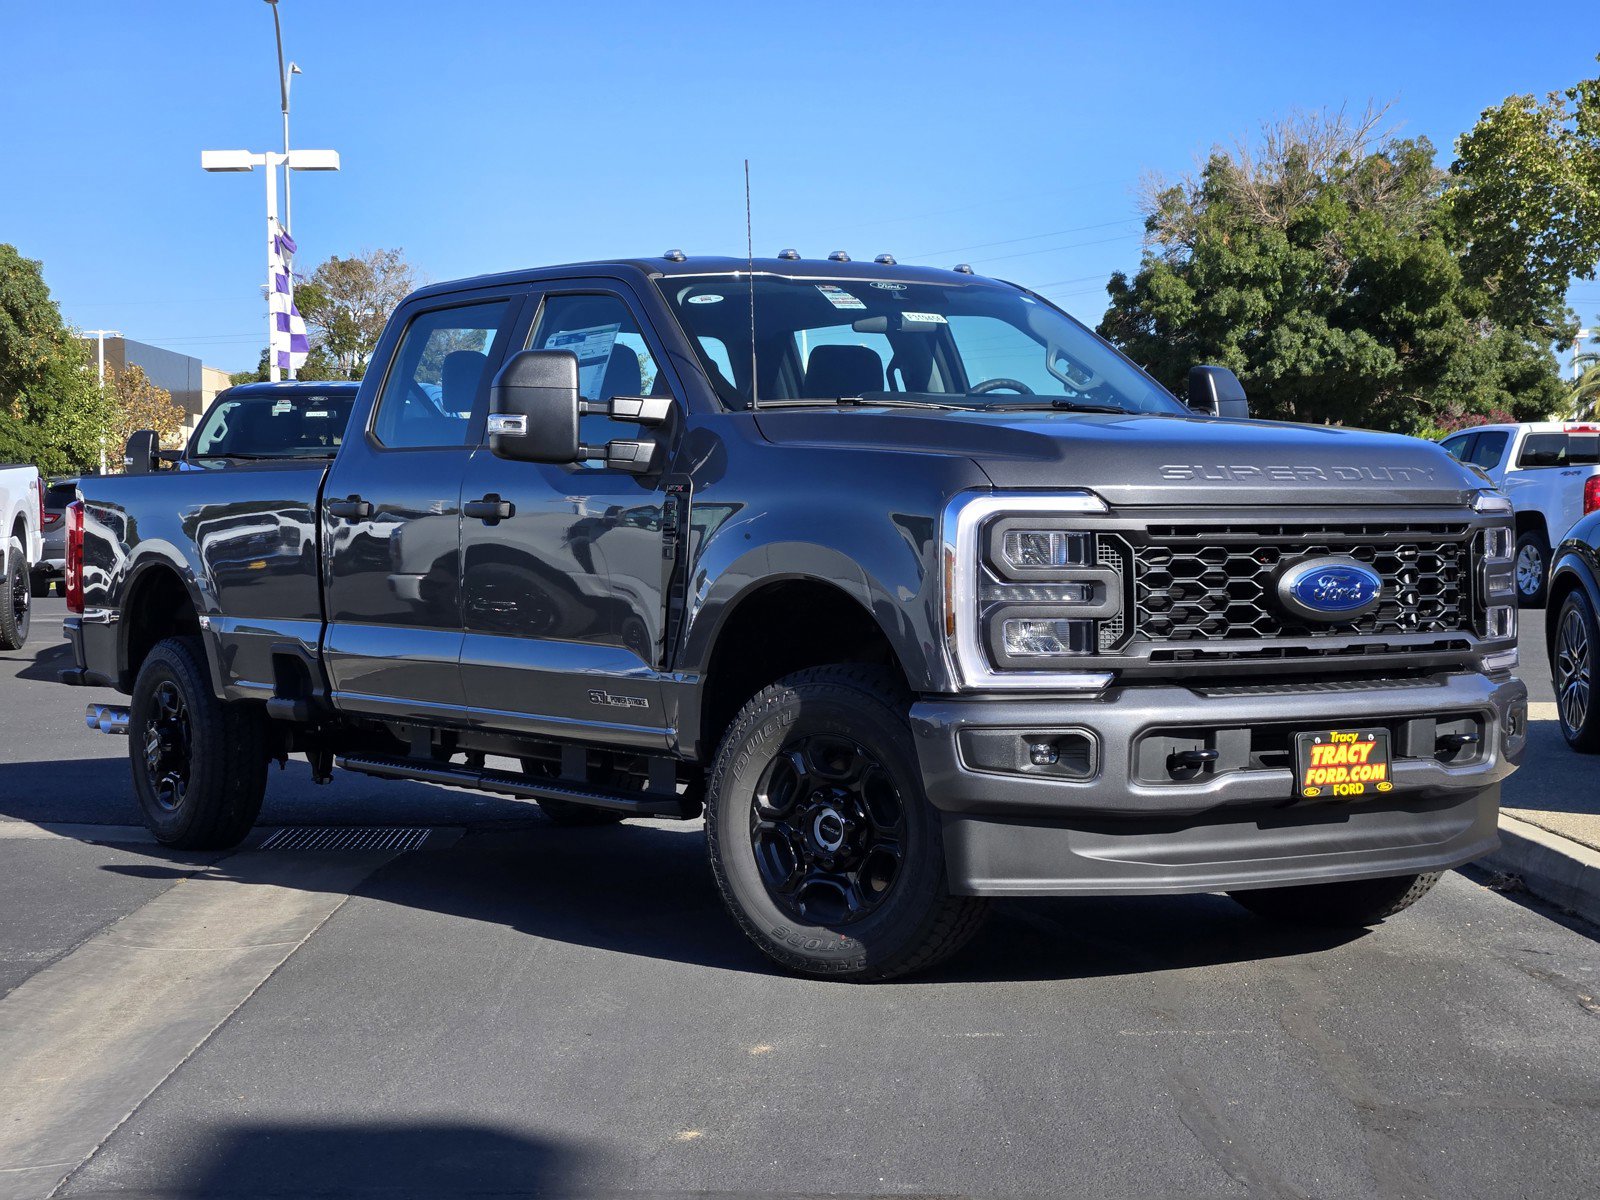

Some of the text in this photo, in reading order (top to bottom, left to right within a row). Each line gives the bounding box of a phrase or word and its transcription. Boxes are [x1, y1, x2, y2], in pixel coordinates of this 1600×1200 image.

[877, 281, 901, 290] Ford
[1159, 464, 1434, 482] SUPER DUTY
[1314, 574, 1361, 601] Ford
[1330, 731, 1359, 744] Tracy
[1311, 741, 1376, 767] TRACY
[1305, 763, 1387, 786] FORD.COM
[1333, 782, 1365, 796] FORD
